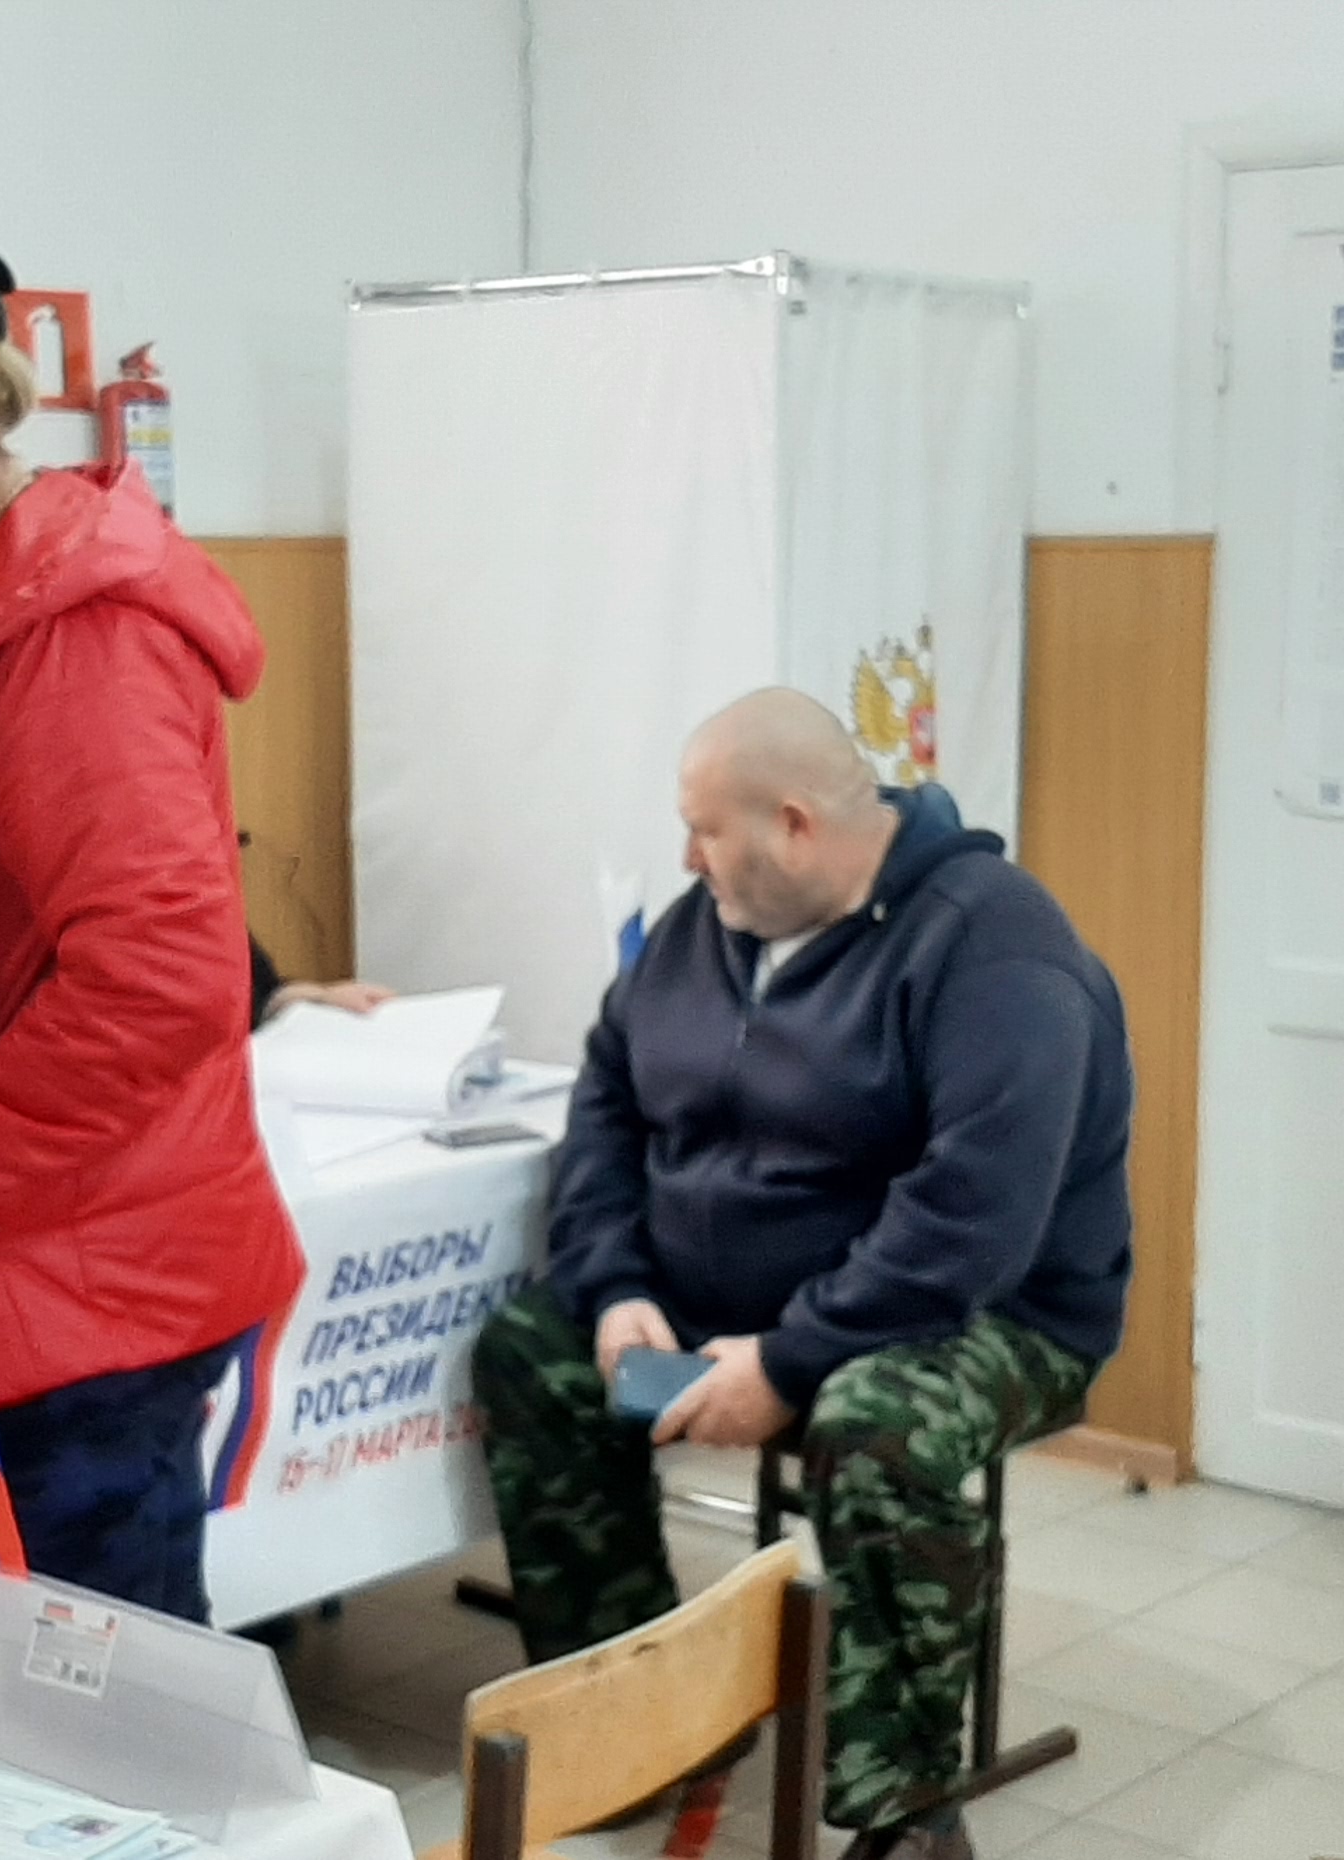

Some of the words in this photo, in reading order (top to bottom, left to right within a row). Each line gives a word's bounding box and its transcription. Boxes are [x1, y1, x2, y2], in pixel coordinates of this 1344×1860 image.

[327, 1222, 494, 1300] ВЫБОРЫ
[292, 1352, 437, 1436] РОССИИ
[352, 1410, 441, 1467] МАРТА
